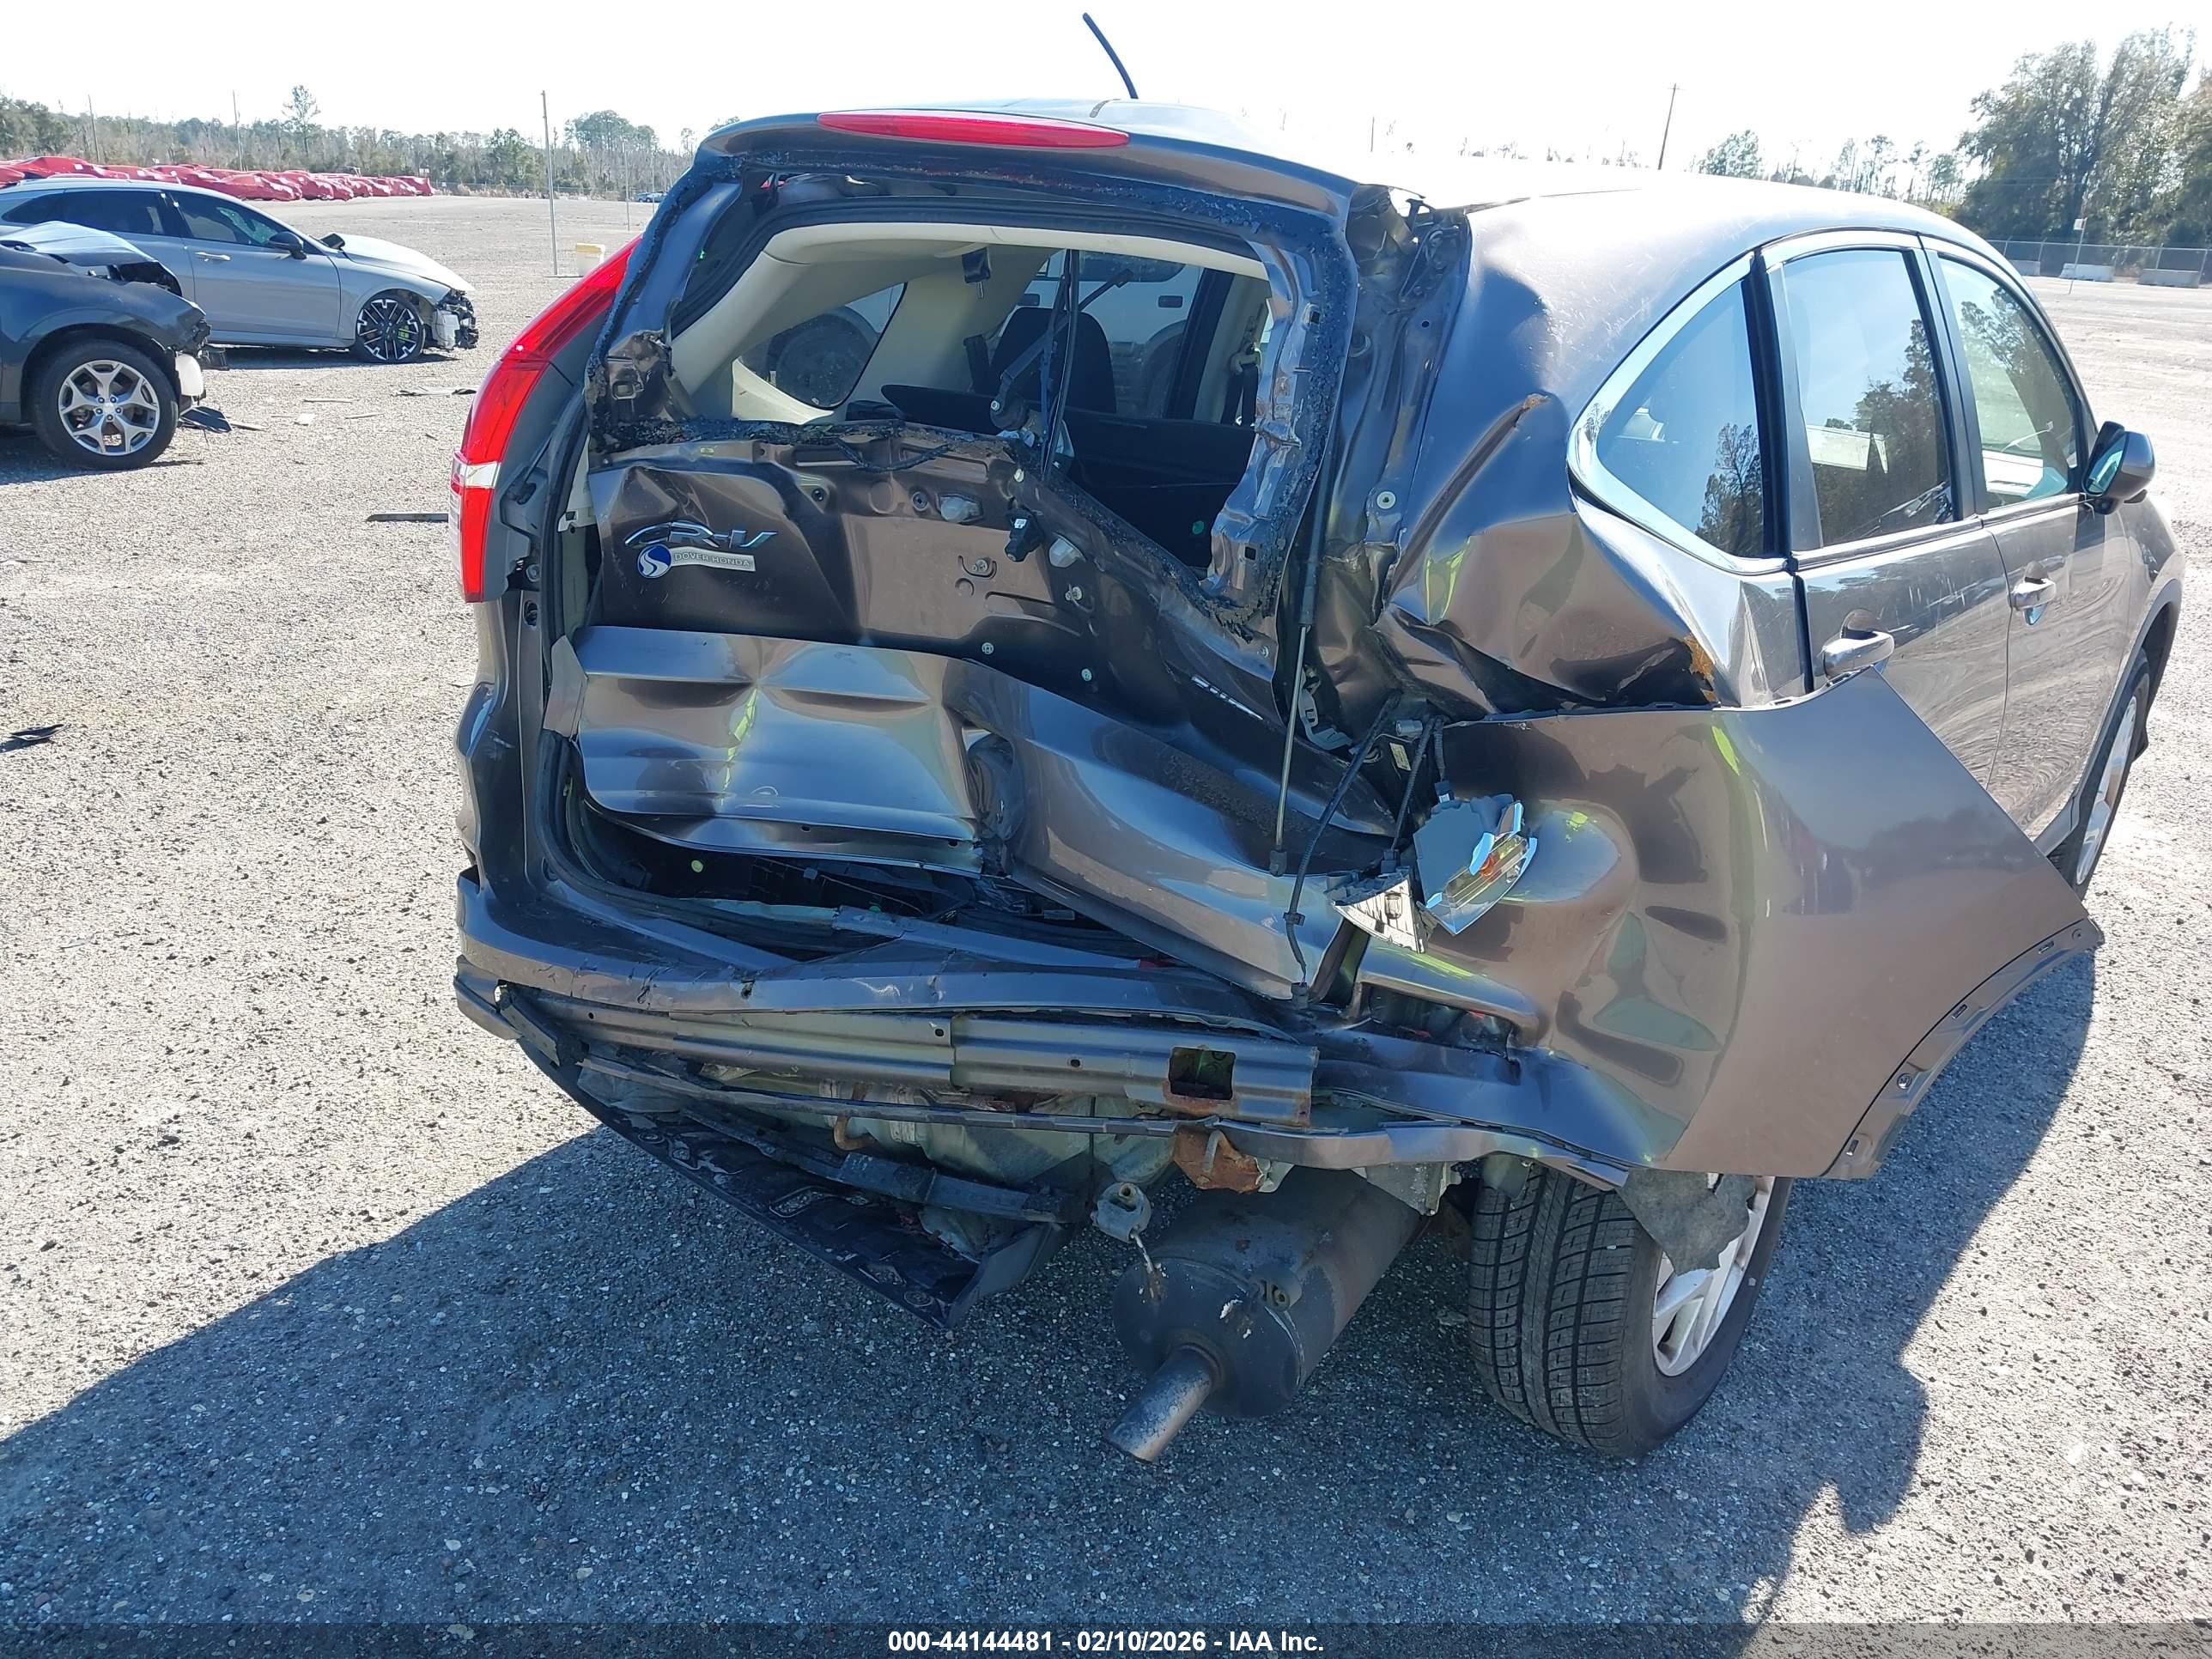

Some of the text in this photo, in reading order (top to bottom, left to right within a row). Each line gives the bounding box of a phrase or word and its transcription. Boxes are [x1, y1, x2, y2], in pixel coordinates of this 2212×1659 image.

[624, 520, 778, 549] CR-V
[674, 551, 750, 567] DOVER HONDA
